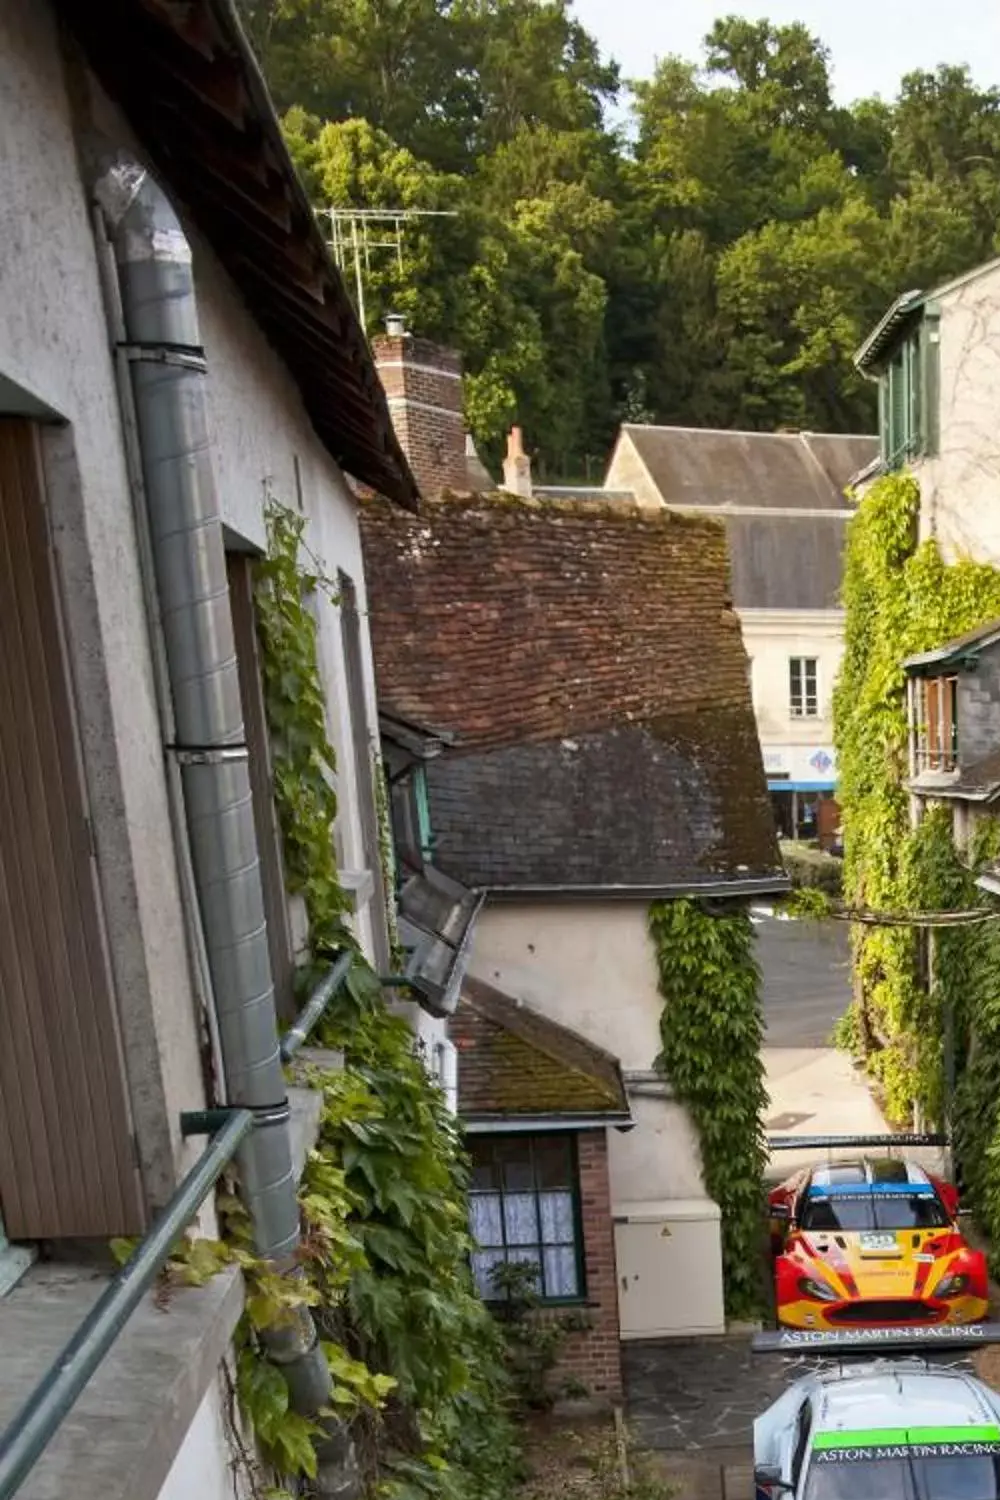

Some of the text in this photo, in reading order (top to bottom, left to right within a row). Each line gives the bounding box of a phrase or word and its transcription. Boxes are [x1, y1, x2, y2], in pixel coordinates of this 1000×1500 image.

[781, 1325, 984, 1343] ASTON MARTIN RACING
[817, 1447, 874, 1462] ASTON
[876, 1445, 937, 1458] MARTIN
